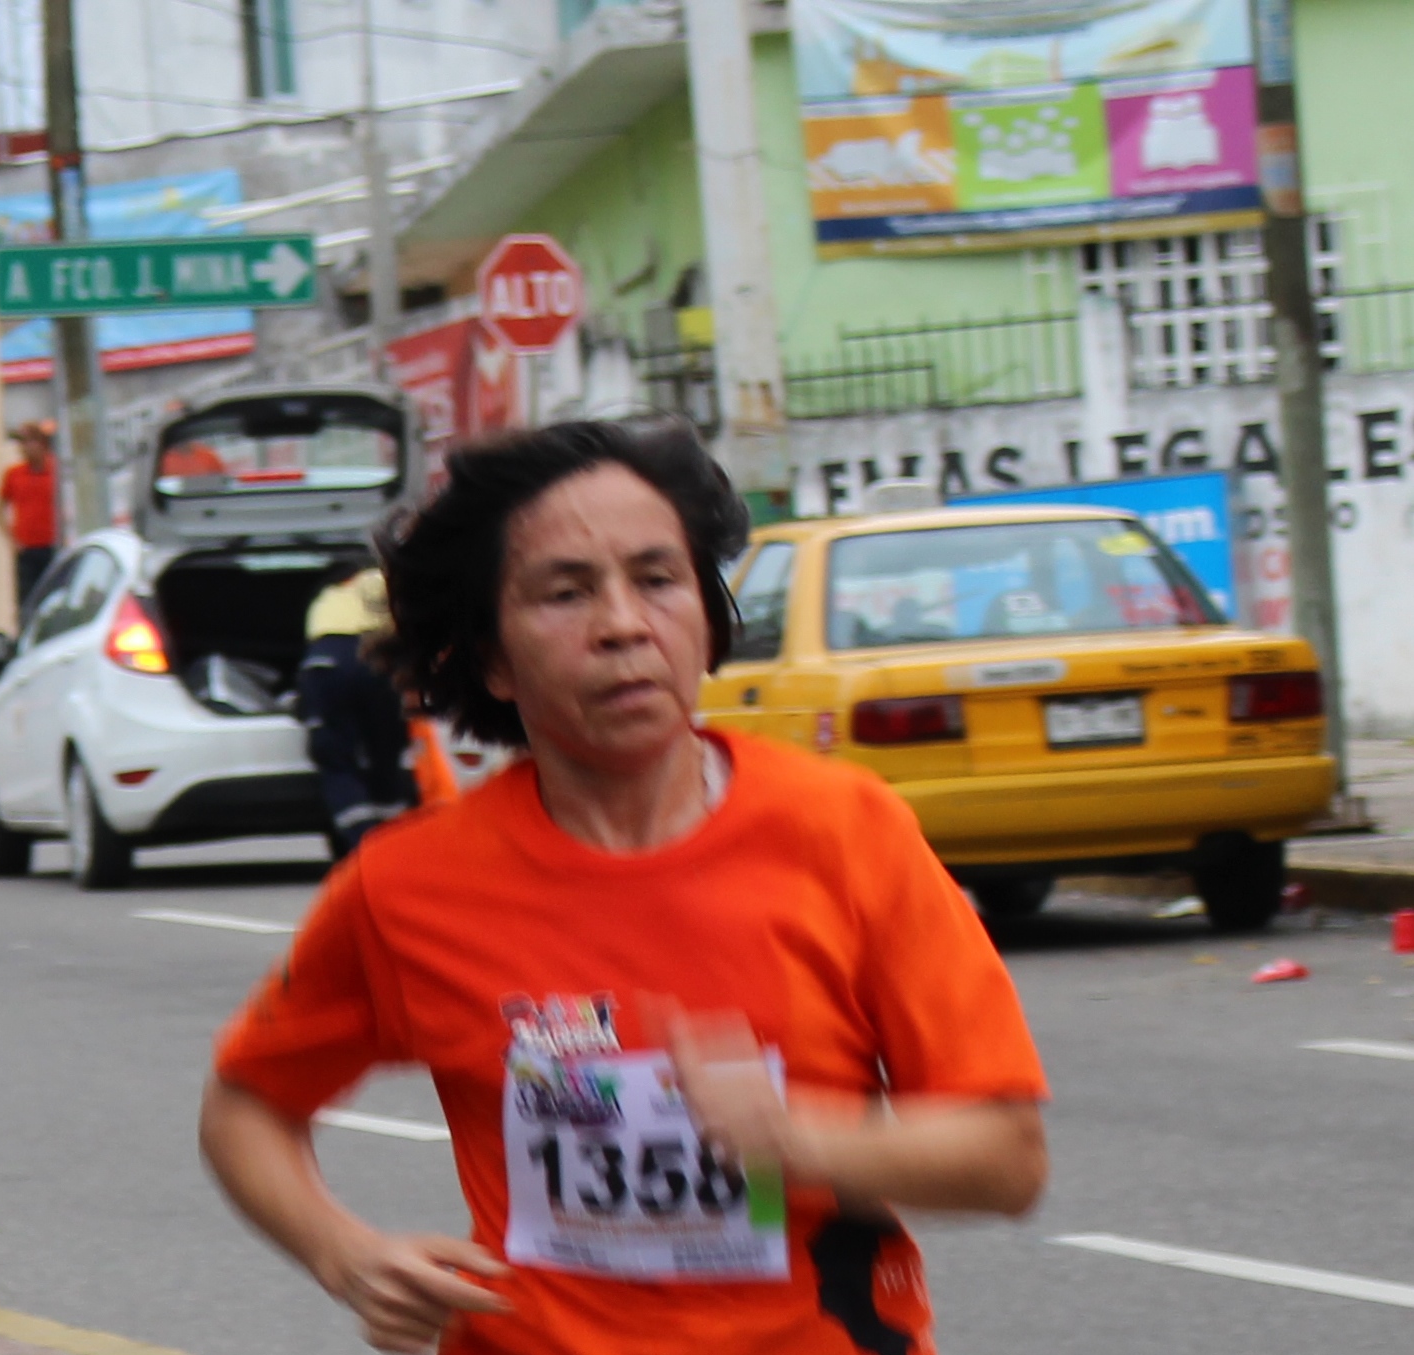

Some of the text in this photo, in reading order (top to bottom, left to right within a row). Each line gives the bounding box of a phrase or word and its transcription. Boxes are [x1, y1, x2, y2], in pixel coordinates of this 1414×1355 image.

[4, 259, 32, 302] A
[491, 269, 573, 318] ALTO
[1064, 409, 1414, 483] LEGAE
[526, 1133, 748, 1217] 1358
